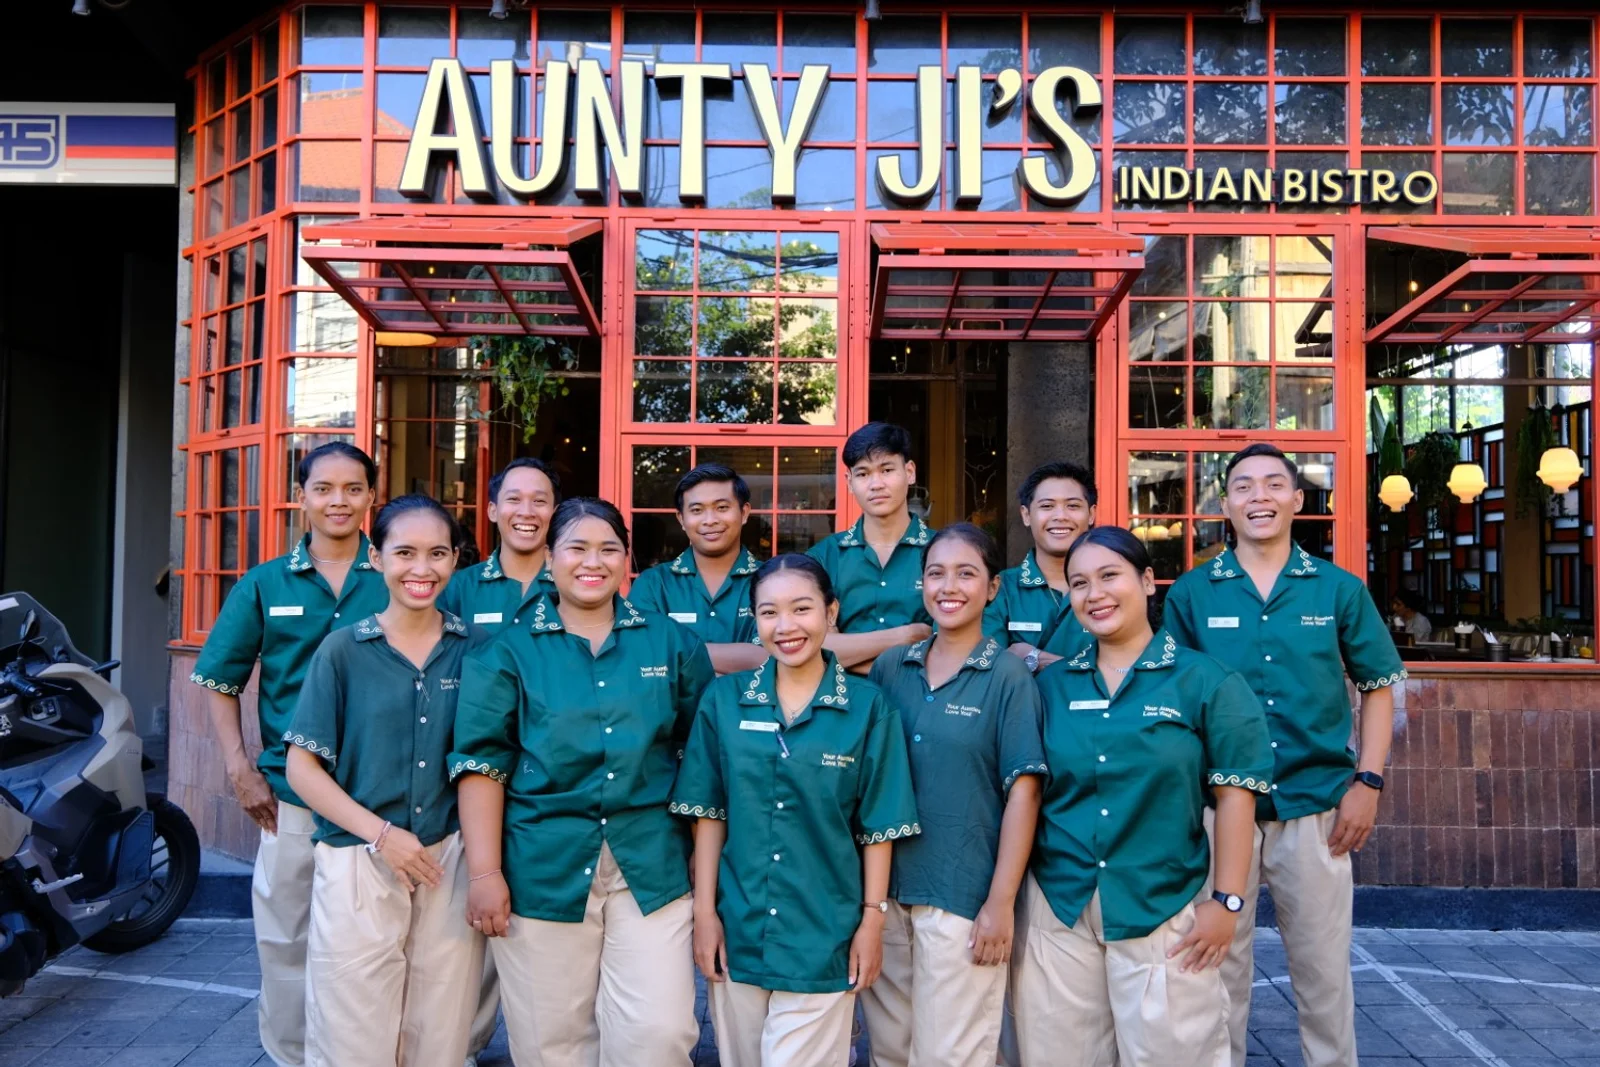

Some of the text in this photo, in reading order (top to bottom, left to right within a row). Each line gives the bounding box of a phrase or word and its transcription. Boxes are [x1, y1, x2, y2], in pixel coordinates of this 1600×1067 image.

[399, 57, 1102, 203] AUNTY JI'S
[1119, 166, 1438, 205] INDIAN BISTRO
